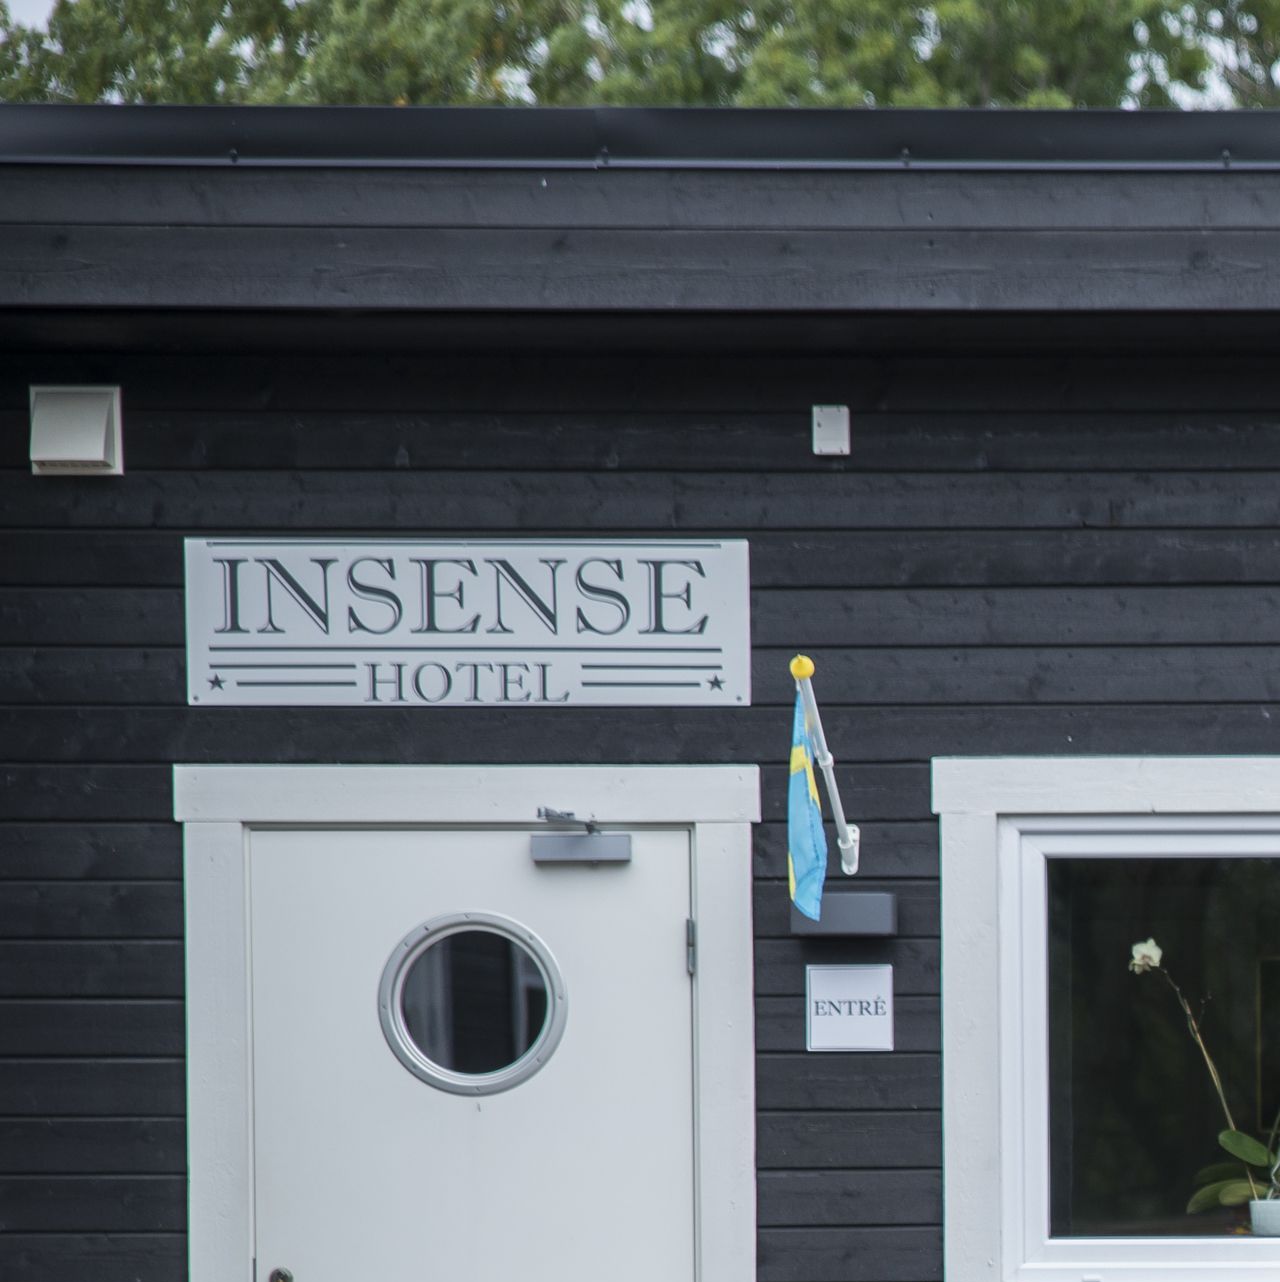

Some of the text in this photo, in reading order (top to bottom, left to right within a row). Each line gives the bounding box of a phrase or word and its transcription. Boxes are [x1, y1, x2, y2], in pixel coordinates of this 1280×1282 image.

[213, 557, 709, 635] INSENSE
[365, 662, 570, 702] HOTEL
[814, 995, 887, 1016] ENTRÉ
